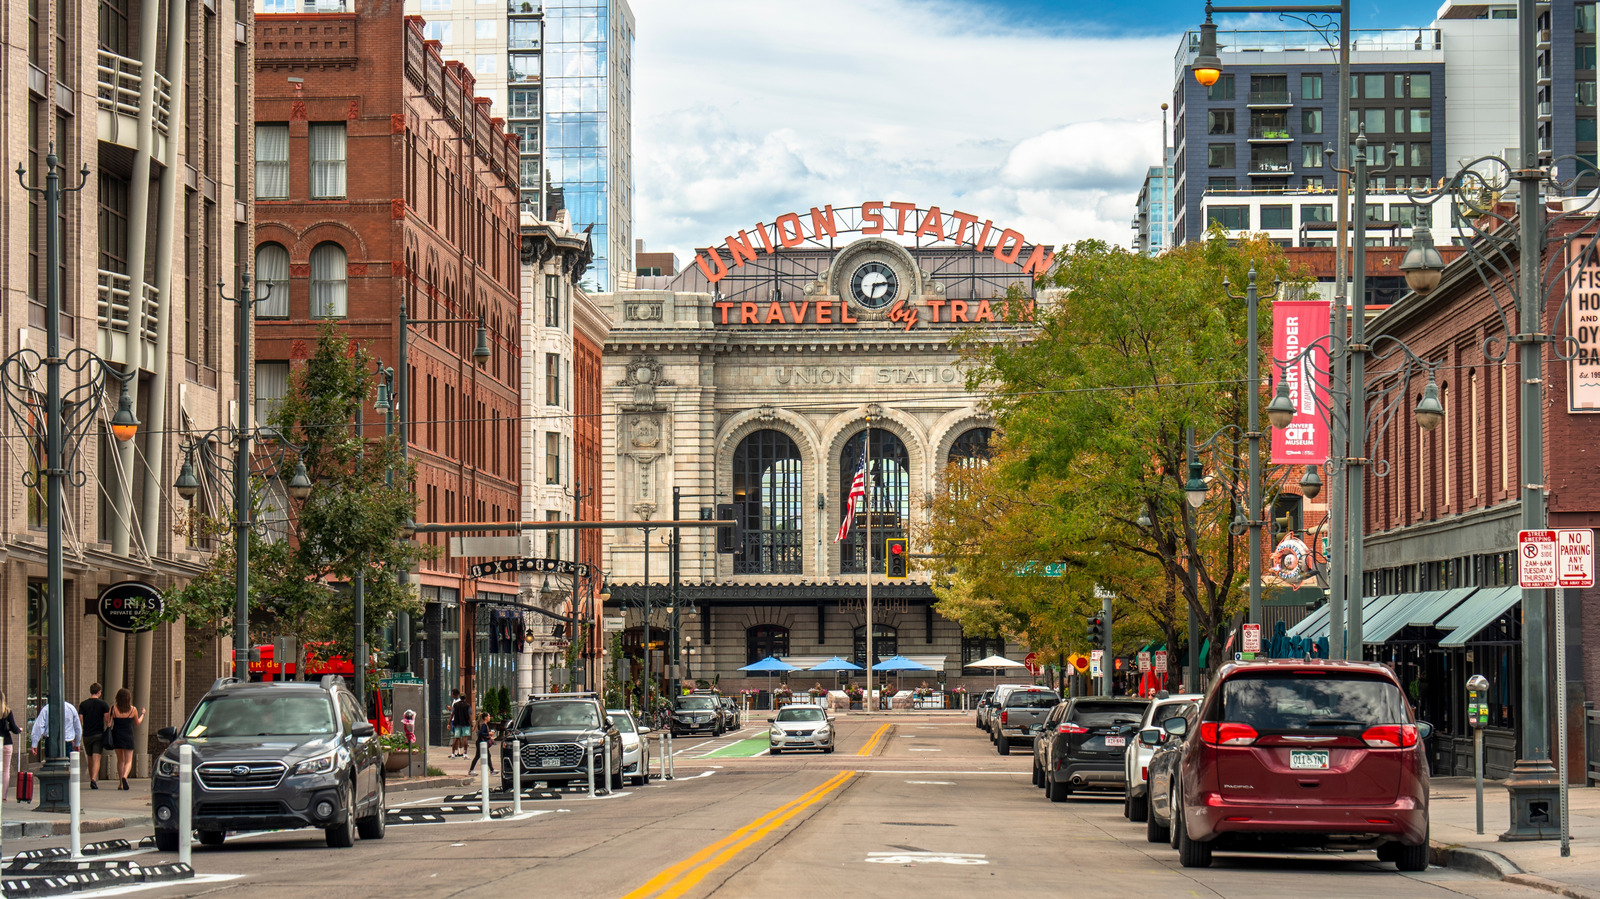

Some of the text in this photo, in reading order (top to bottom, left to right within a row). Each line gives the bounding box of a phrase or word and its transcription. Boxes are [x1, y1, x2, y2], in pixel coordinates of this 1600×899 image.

[695, 201, 1055, 284] UNION STATION
[715, 300, 1036, 332] TRAVEL by TRAIN
[1286, 316, 1299, 416] ESERT RIDER
[774, 367, 854, 385] UNION
[1285, 424, 1315, 440] art
[1568, 533, 1582, 543] NO
[1560, 544, 1590, 555] PARKING
[472, 559, 587, 578] OXFORD
[838, 598, 909, 614] CRAWFORD
